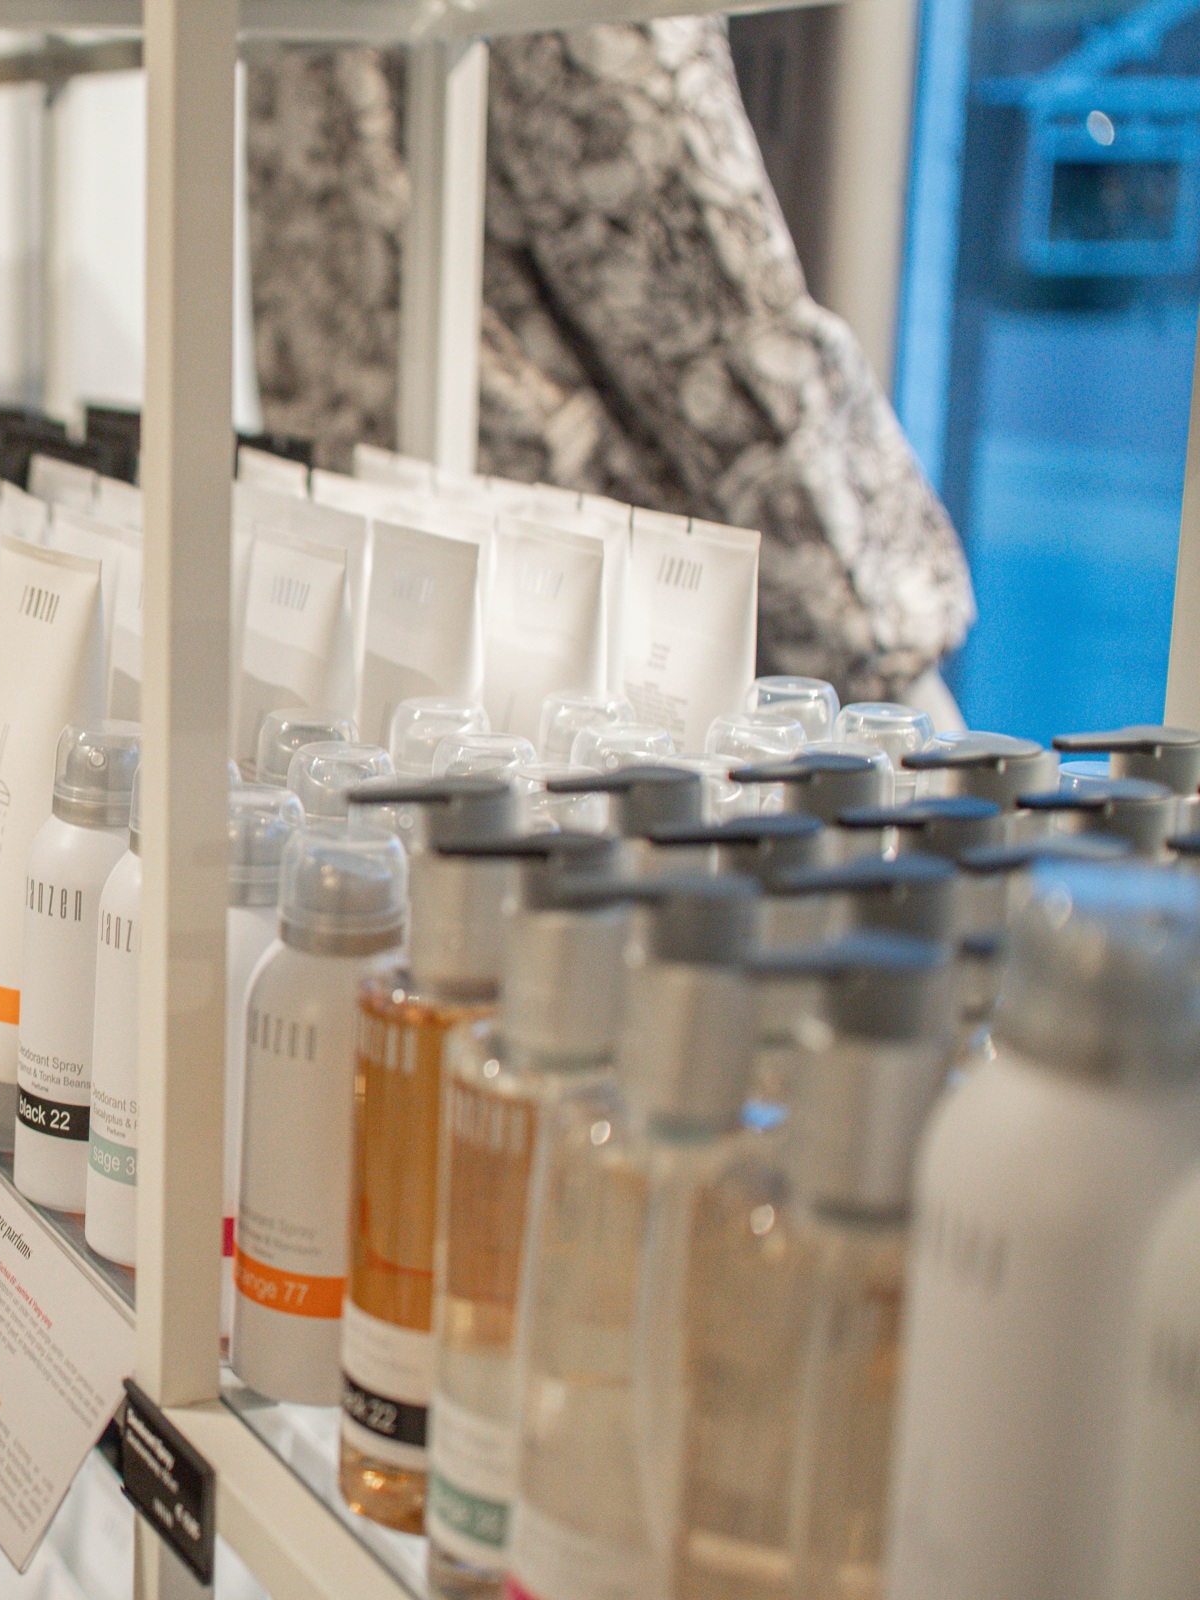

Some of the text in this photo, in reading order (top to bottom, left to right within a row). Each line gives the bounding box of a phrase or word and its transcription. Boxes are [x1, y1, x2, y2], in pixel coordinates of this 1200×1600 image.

[52, 1056, 84, 1076] Spray
[40, 1070, 61, 1085] Tonka
[63, 1076, 91, 1090] Beans
[20, 1093, 71, 1131] black 22
[125, 1117, 132, 1129] &
[93, 1145, 136, 1175] sage 3
[3, 1226, 33, 1260] parfums
[283, 1280, 309, 1306] 77
